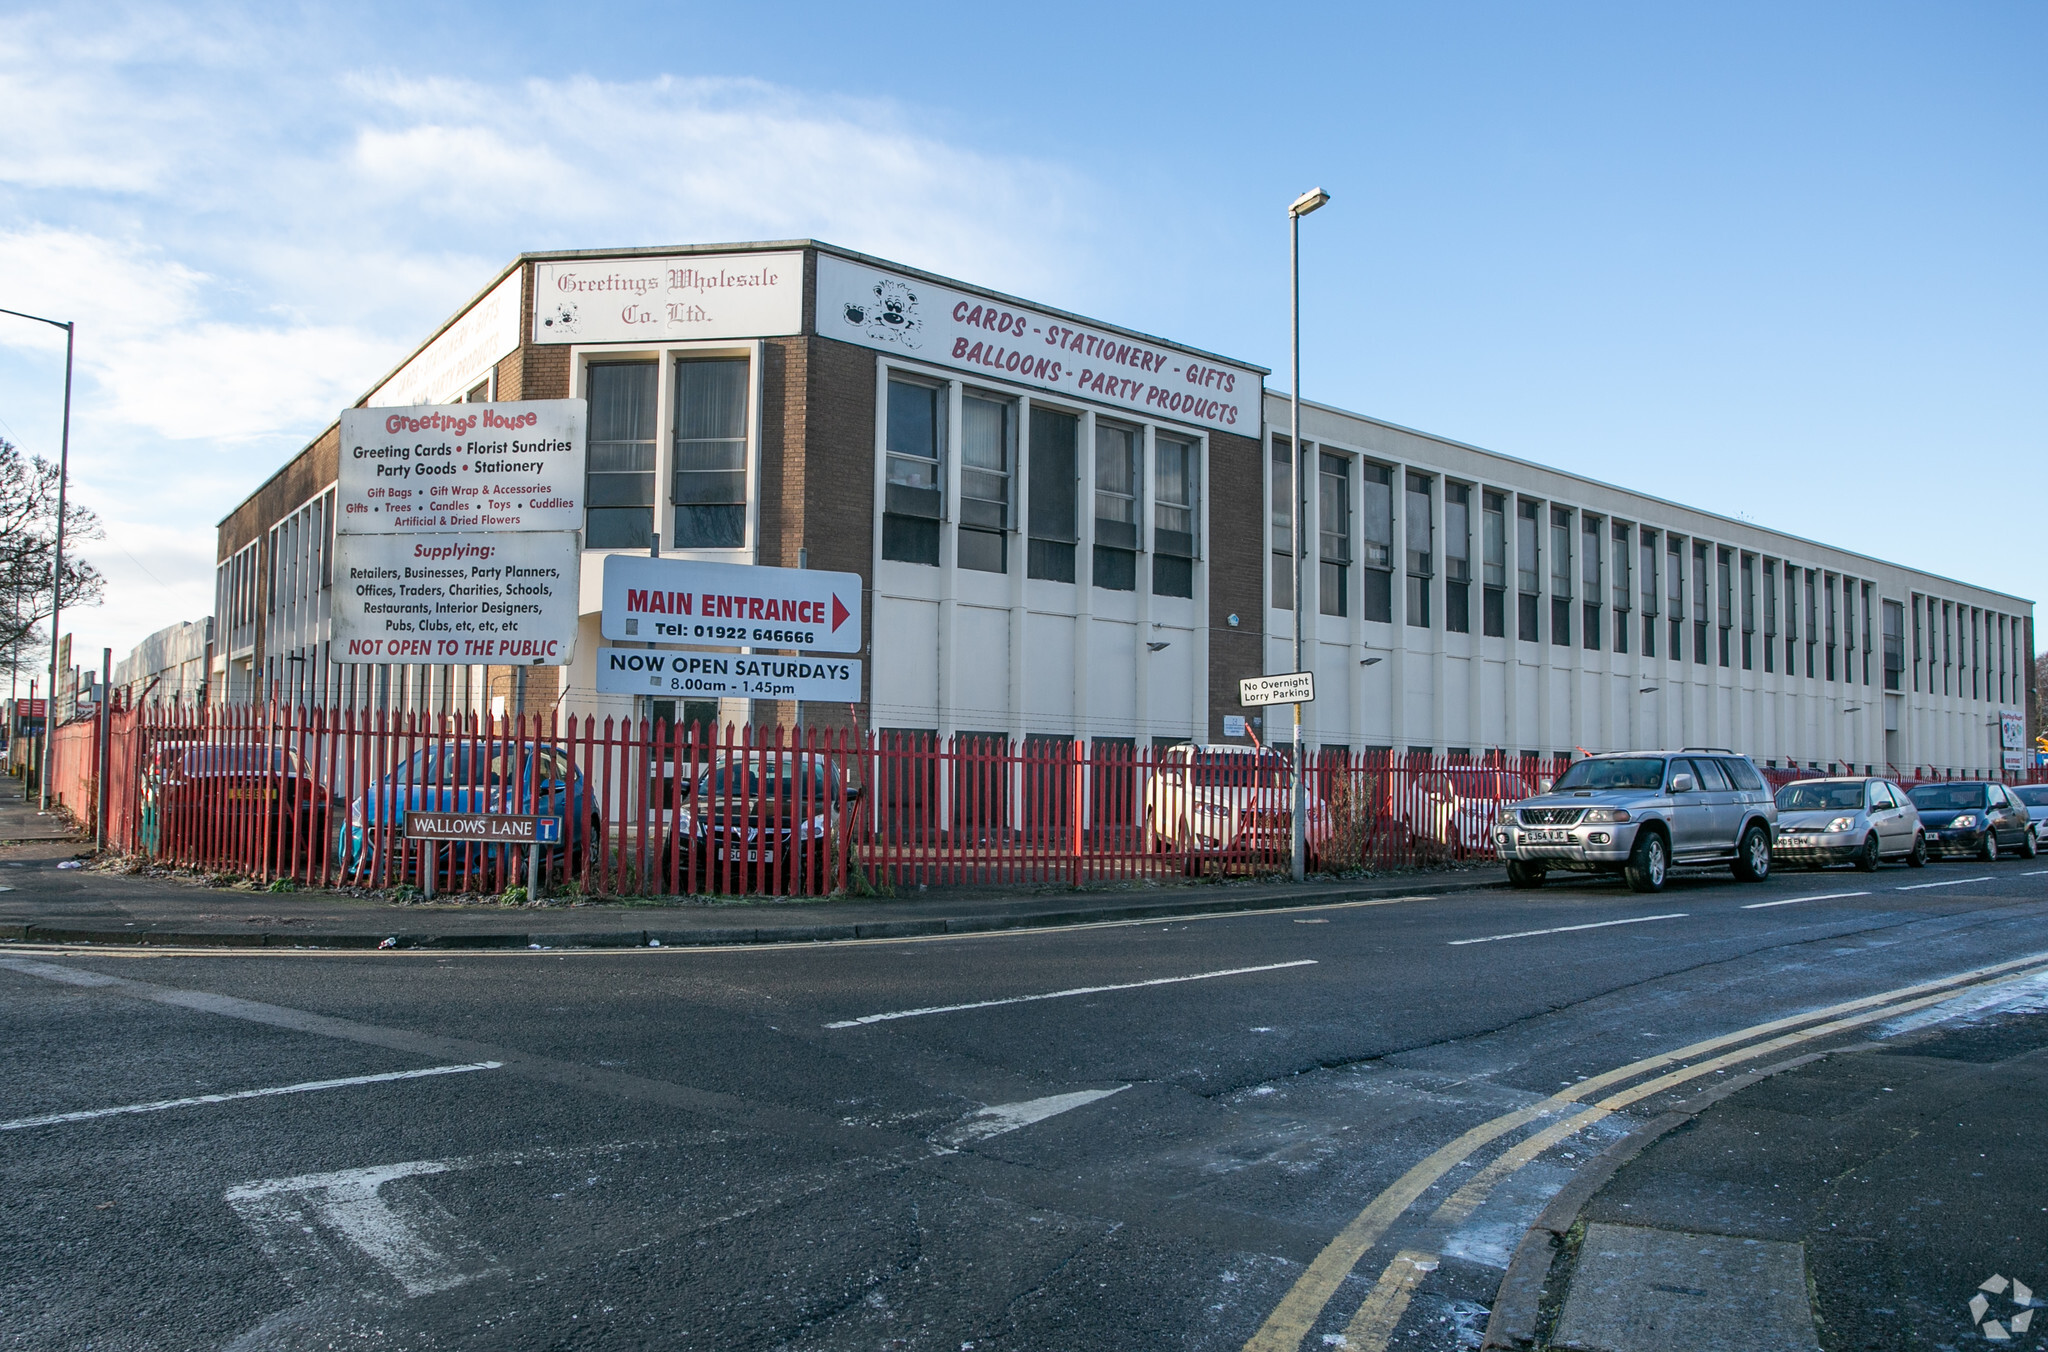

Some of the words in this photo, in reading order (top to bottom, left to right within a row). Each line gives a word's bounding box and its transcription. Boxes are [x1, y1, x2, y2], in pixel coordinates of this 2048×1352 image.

[557, 273, 659, 296] Greetings
[667, 267, 778, 294] Wholesale
[622, 304, 658, 325] Co.
[666, 302, 713, 329] Ltd.
[952, 301, 1026, 337] CARDS
[1045, 325, 1167, 373] STATIONERY
[1185, 364, 1235, 393] GIFTS
[952, 337, 1061, 382] BALLOONS
[1078, 368, 1145, 401] PARTY
[1146, 385, 1238, 425] PRODUCTS
[386, 411, 477, 436] Greetings
[483, 409, 537, 431] House
[353, 444, 410, 461] Greeting
[415, 443, 451, 457] Cards
[467, 441, 508, 454] Florist
[512, 439, 572, 453] Sundries
[377, 464, 410, 479] Party
[415, 462, 457, 475] Goods
[474, 460, 544, 474] Stationery
[367, 488, 386, 498] Gift
[388, 488, 412, 499] Bags
[430, 486, 448, 496] Gift
[451, 486, 478, 497] Wrap
[483, 486, 490, 494] &
[493, 484, 551, 494] Accessories
[346, 504, 368, 513] Gifts
[385, 503, 411, 512] Trees
[430, 501, 469, 511] Candles
[488, 500, 511, 511] Toys
[530, 499, 574, 509] Cuddlies
[395, 516, 436, 527] Artificial
[440, 516, 447, 525] &
[451, 515, 478, 525] Dried
[481, 514, 520, 524] Flowers
[414, 544, 495, 560] Supplying:
[350, 567, 401, 580] Retailers,
[404, 567, 468, 579] Businesses,
[471, 566, 501, 579] Party
[505, 565, 560, 579] Planners,
[356, 584, 396, 597] Offices,
[400, 584, 445, 597] Traders,
[449, 584, 502, 596] Charities,
[506, 583, 552, 597] Schools,
[364, 602, 432, 615] Restaurants,
[436, 602, 478, 613] Interior
[482, 602, 542, 615] Designers,
[627, 589, 693, 615] MAIN
[701, 594, 825, 624] ENTRANCE
[386, 620, 415, 632] Pubs,
[419, 619, 451, 632] Clubs,
[456, 621, 474, 633] etc,
[479, 621, 498, 632] etc,
[502, 620, 518, 631] etc
[655, 622, 688, 637] Tel:
[694, 625, 747, 640] 01922
[752, 629, 814, 644] 646666
[349, 640, 383, 655] NOT
[387, 640, 432, 655] OPEN
[438, 640, 459, 655] TO
[464, 640, 495, 656] THE
[499, 640, 558, 656] PUBLIC
[610, 655, 665, 672] NOW
[672, 657, 728, 674] OPEN
[735, 660, 850, 680] SATURDAYS
[670, 678, 726, 691] 8.00am
[743, 681, 795, 696] 1.45pm
[1245, 683, 1257, 691] No
[1261, 677, 1309, 689] Overnight
[1245, 693, 1269, 701] Lorry
[1273, 689, 1309, 698] Parking
[414, 818, 486, 834] WALLOWS
[492, 821, 532, 835] LANE
